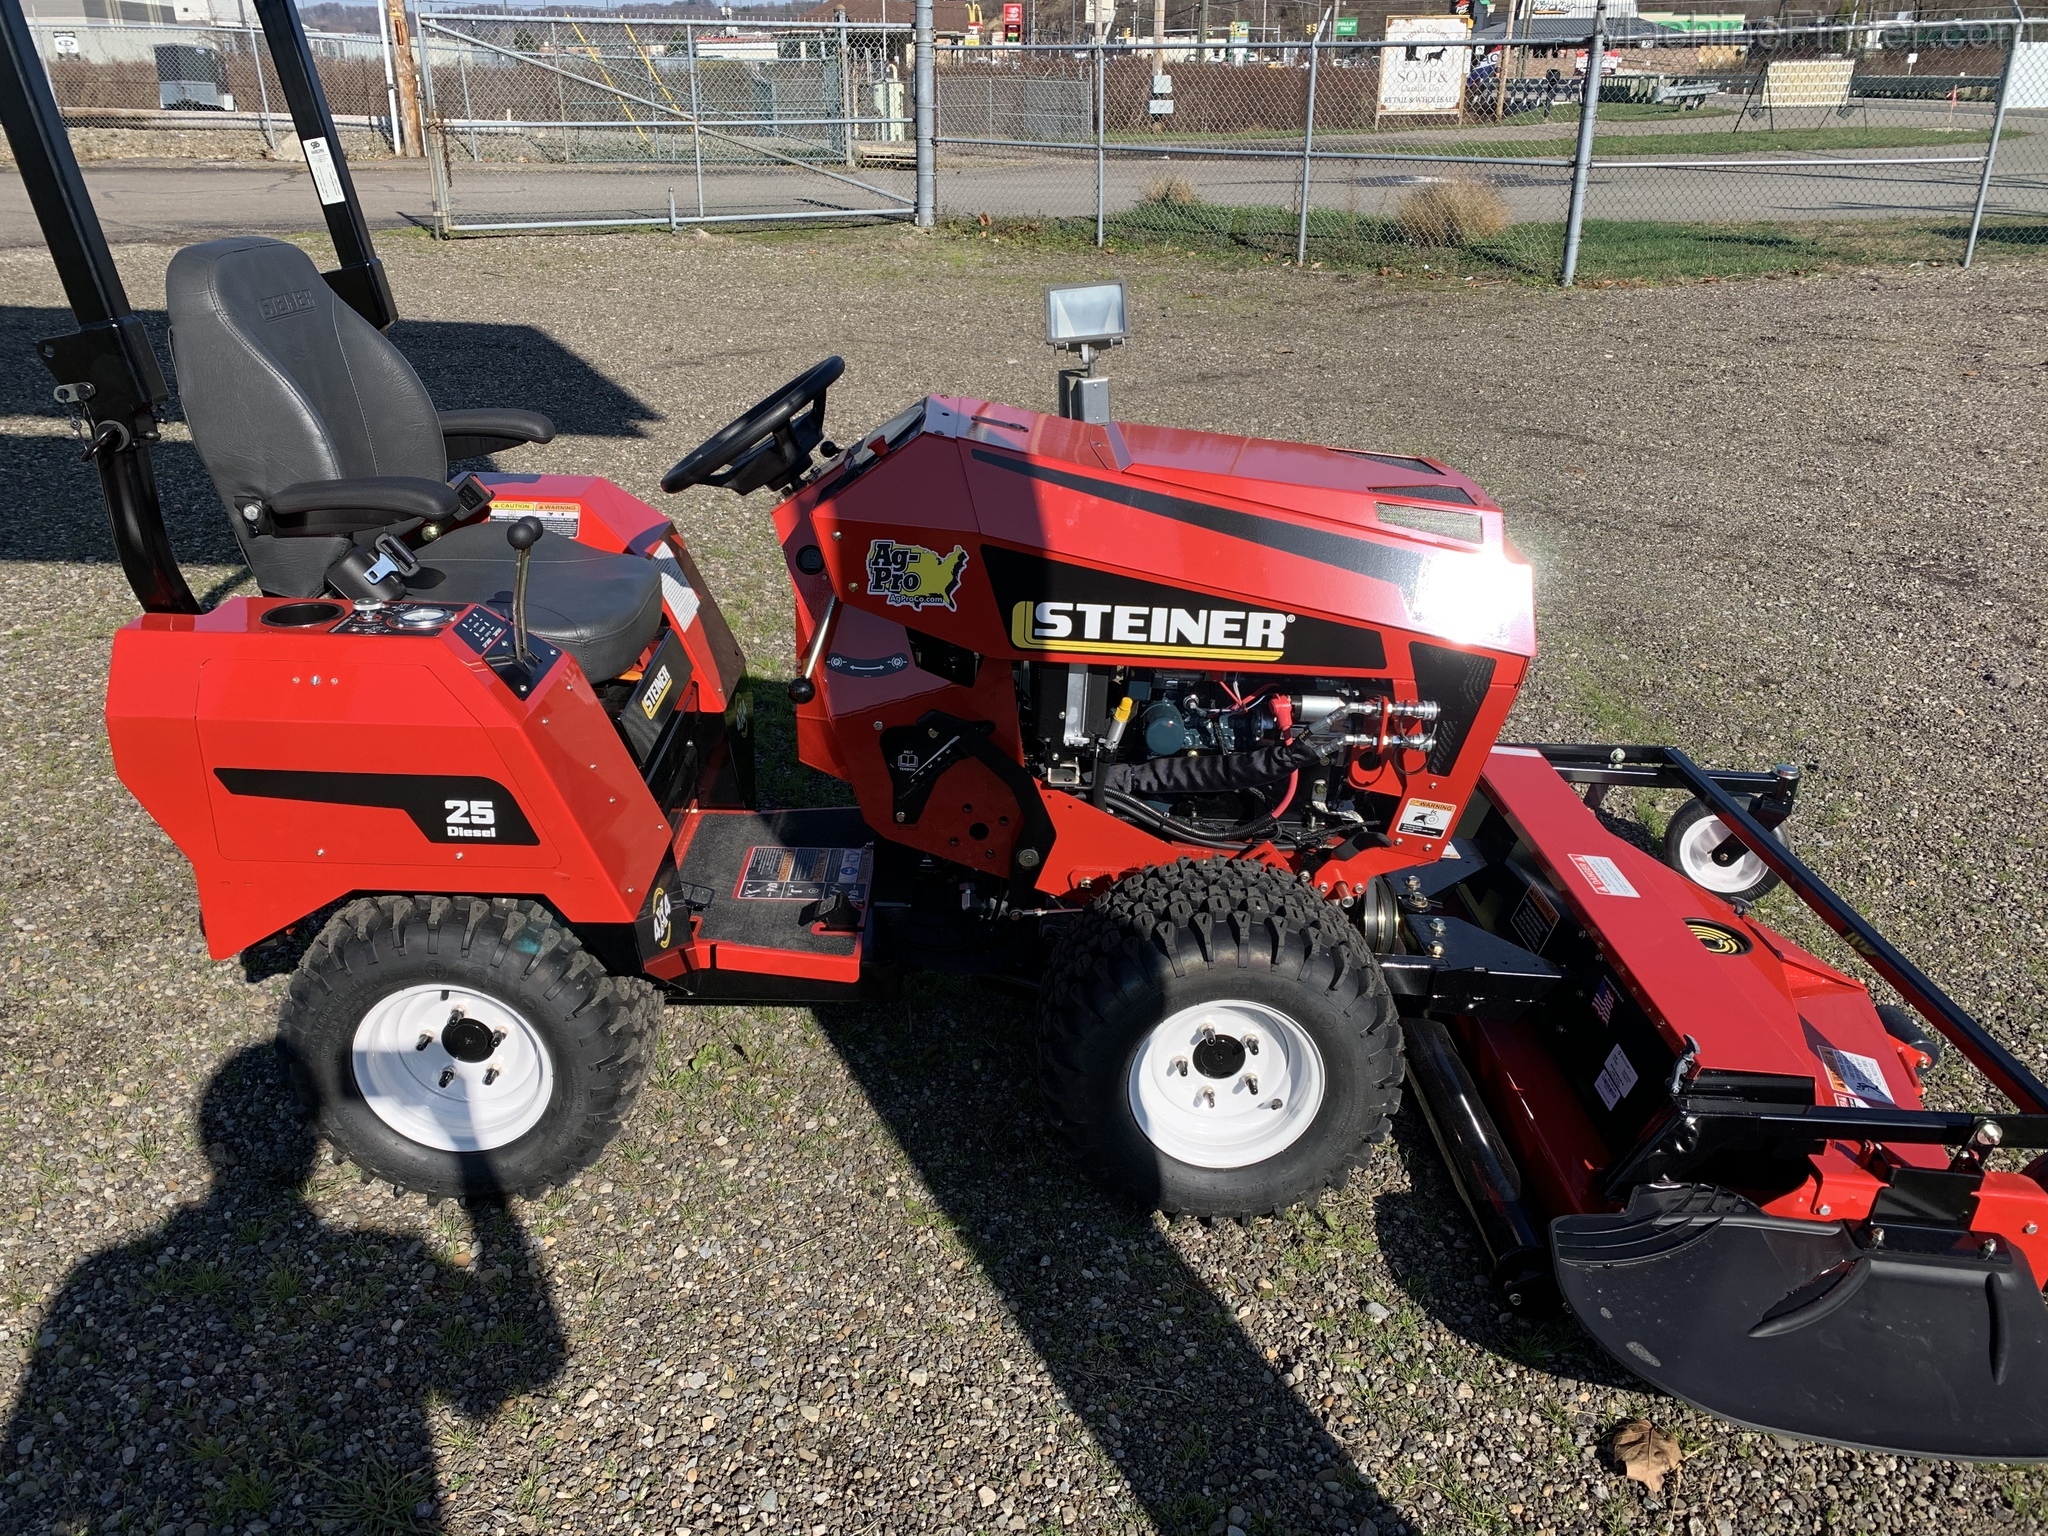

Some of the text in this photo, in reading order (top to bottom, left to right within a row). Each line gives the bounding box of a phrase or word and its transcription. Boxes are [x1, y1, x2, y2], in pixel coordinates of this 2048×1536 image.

[1384, 96, 1408, 104] RETAIL
[870, 567, 922, 592] Pro
[890, 594, 944, 604] AgProCo.com
[642, 663, 672, 712] STEINER
[444, 799, 496, 825] 25
[1420, 801, 1452, 811] WARNING
[446, 826, 496, 838] Diesel
